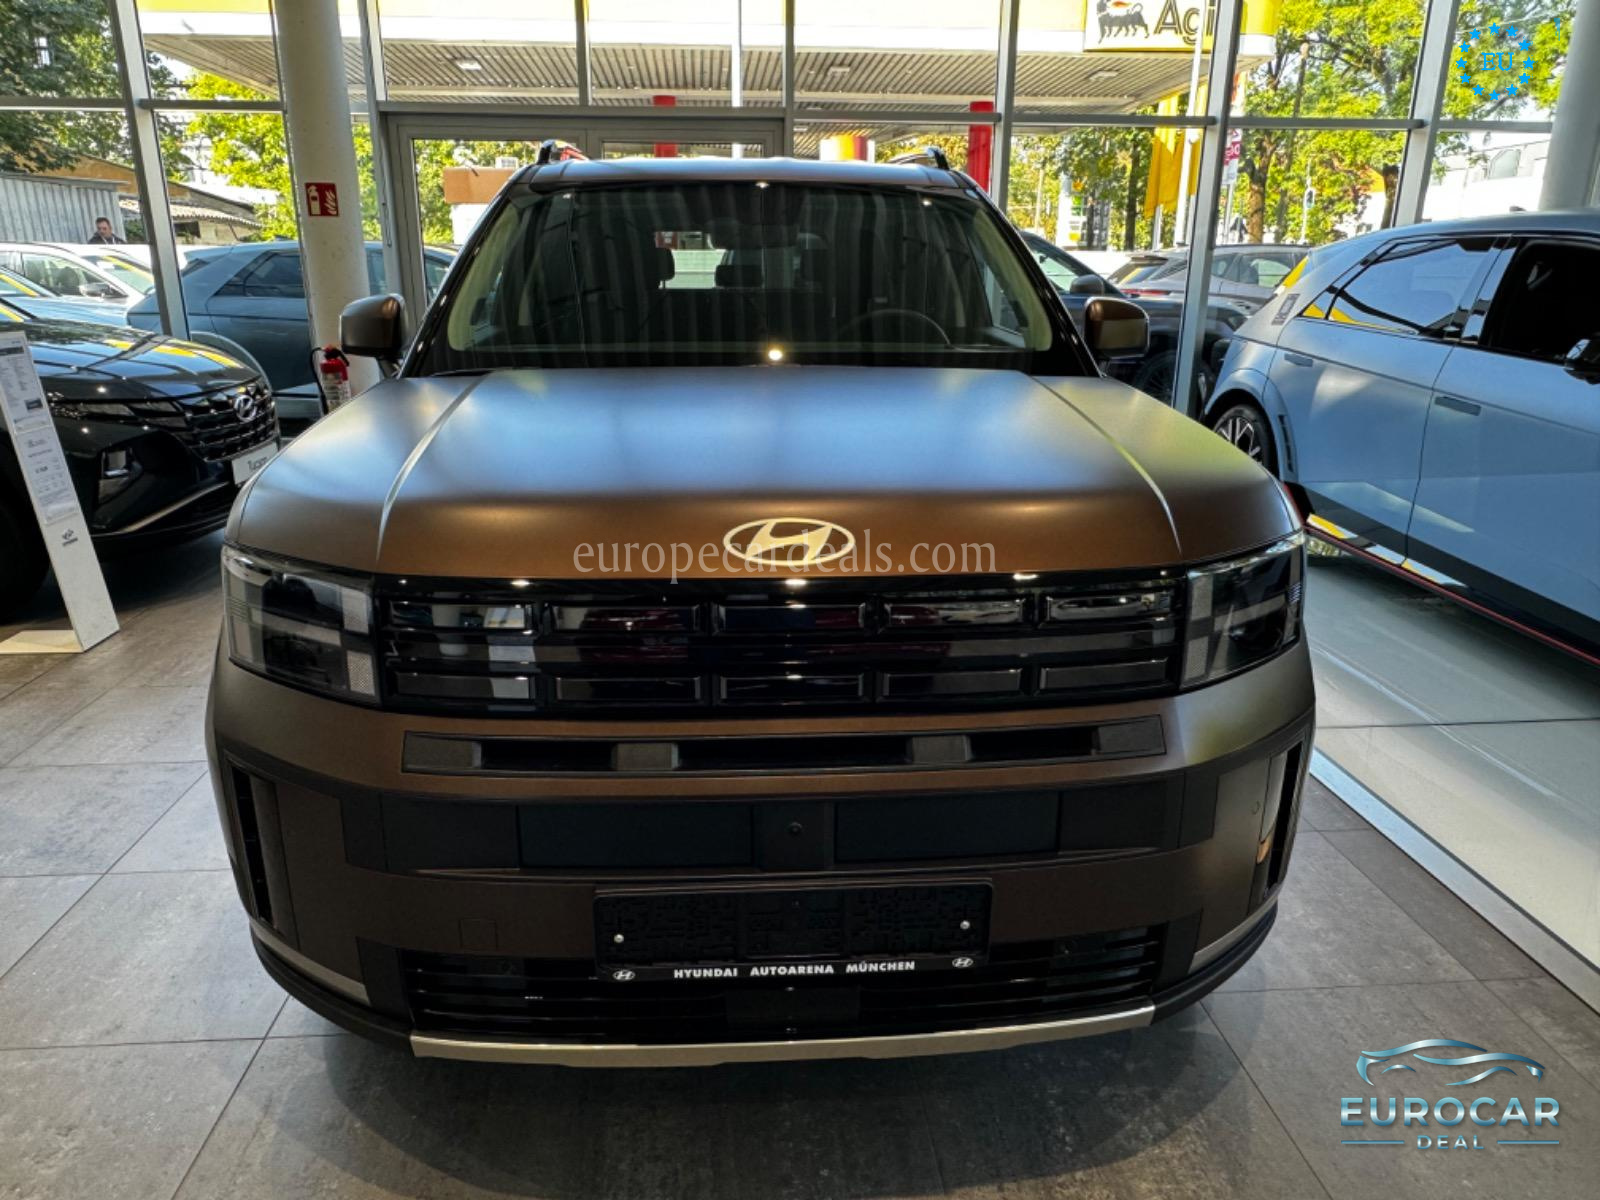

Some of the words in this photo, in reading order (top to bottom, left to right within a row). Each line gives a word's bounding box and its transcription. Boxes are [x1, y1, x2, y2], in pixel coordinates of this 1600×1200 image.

[1153, 0, 1215, 45] Agi
[673, 968, 738, 979] HYUNDAI
[750, 964, 835, 977] AUTOARENA
[845, 960, 916, 974] MÜNCHEN
